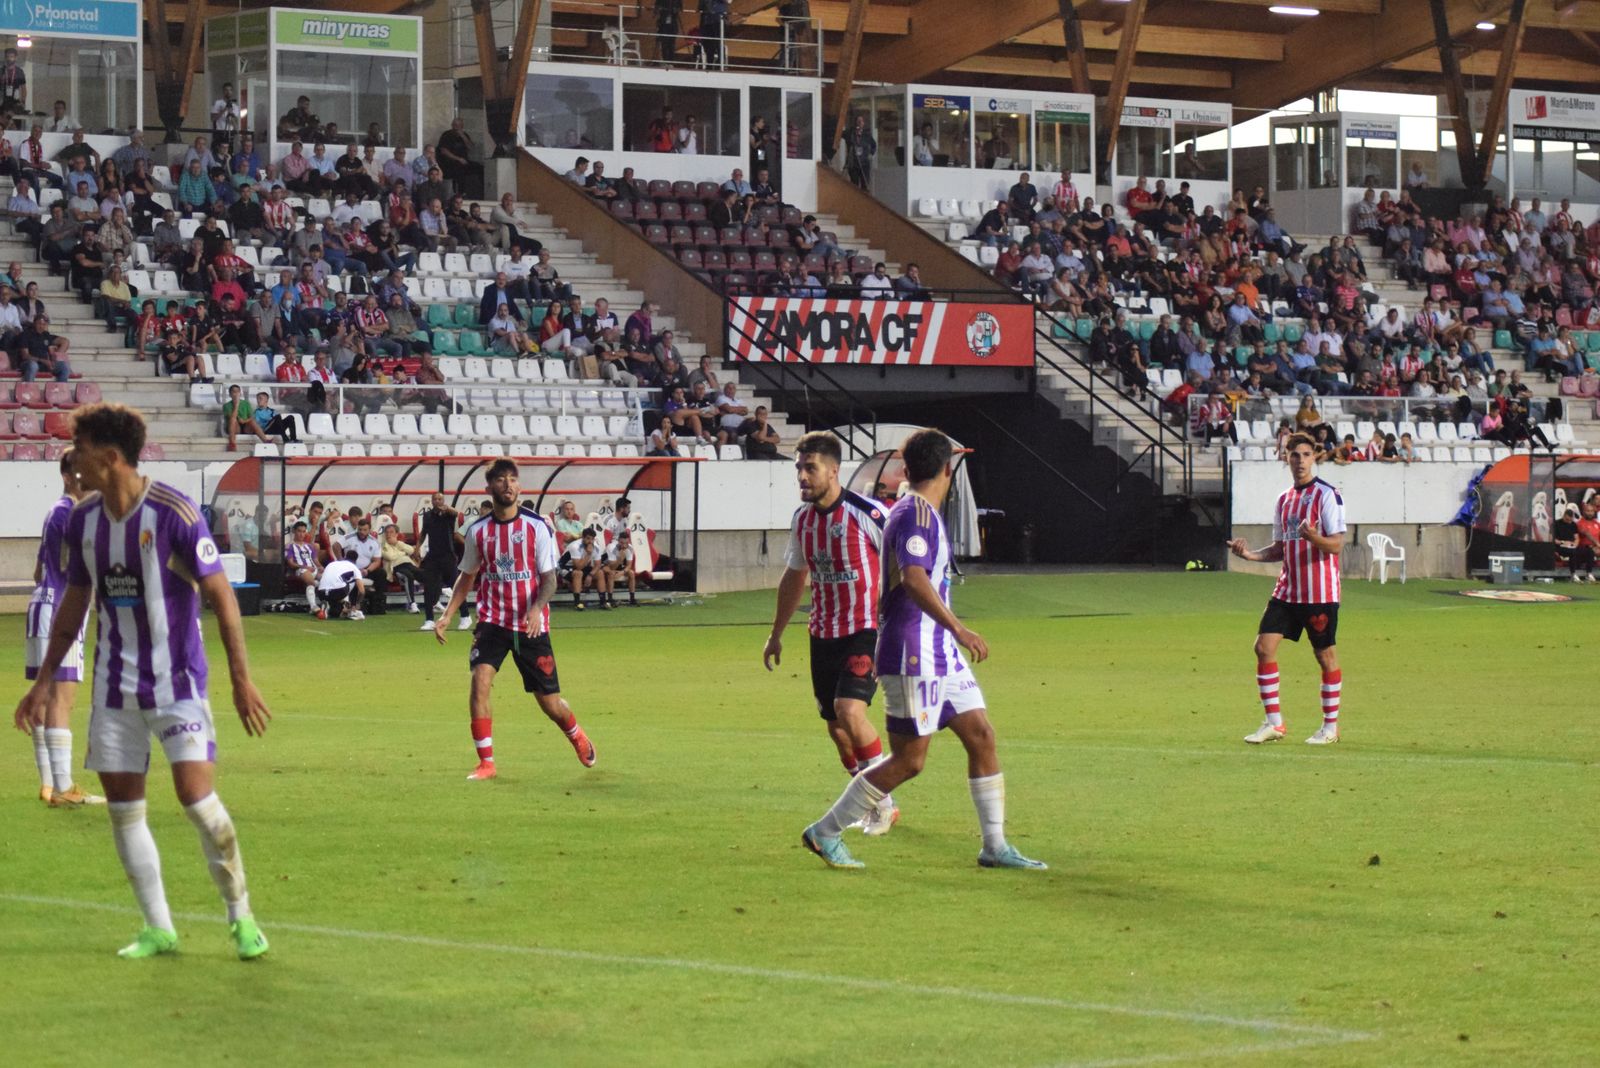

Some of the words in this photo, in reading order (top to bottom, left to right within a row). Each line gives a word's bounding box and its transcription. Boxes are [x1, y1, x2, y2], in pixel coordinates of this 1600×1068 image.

[35, 5, 98, 21] Pronatal
[66, 21, 98, 30] Services
[302, 17, 391, 39] minymas
[1181, 109, 1191, 120] La
[755, 309, 876, 351] ZAMORA
[881, 313, 923, 352] CF
[104, 575, 138, 589] Estrella
[918, 680, 939, 708] 10
